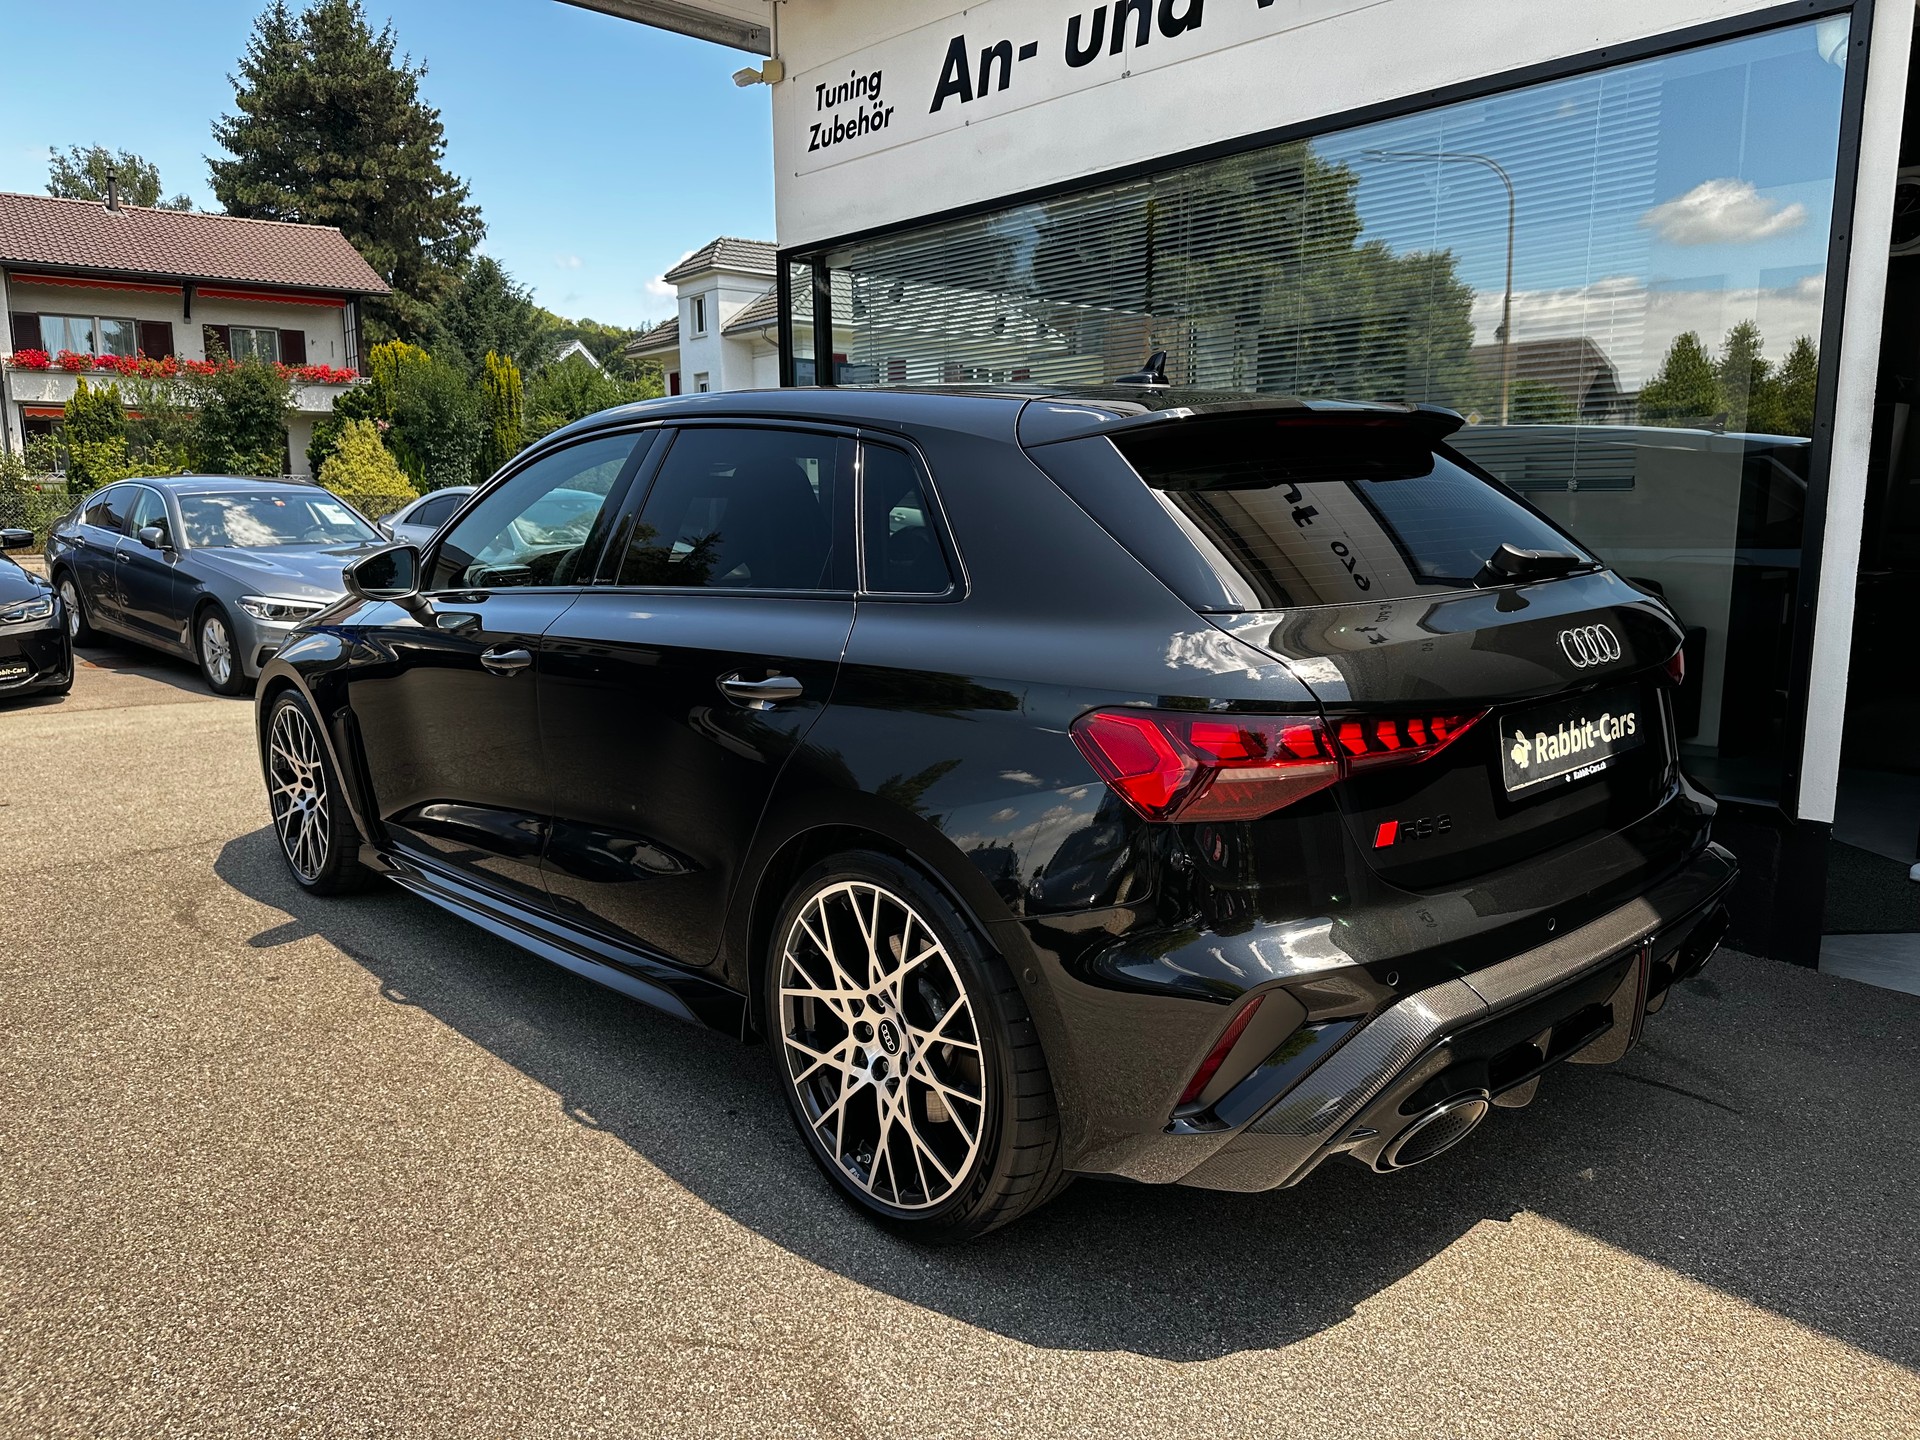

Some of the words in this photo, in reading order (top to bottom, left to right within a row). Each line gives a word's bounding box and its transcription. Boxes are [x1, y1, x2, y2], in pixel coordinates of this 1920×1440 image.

[815, 69, 883, 112] Tuning
[929, 34, 1038, 114] An-
[807, 99, 895, 153] Zubehör
[1535, 712, 1636, 764] Rabbit-Cars
